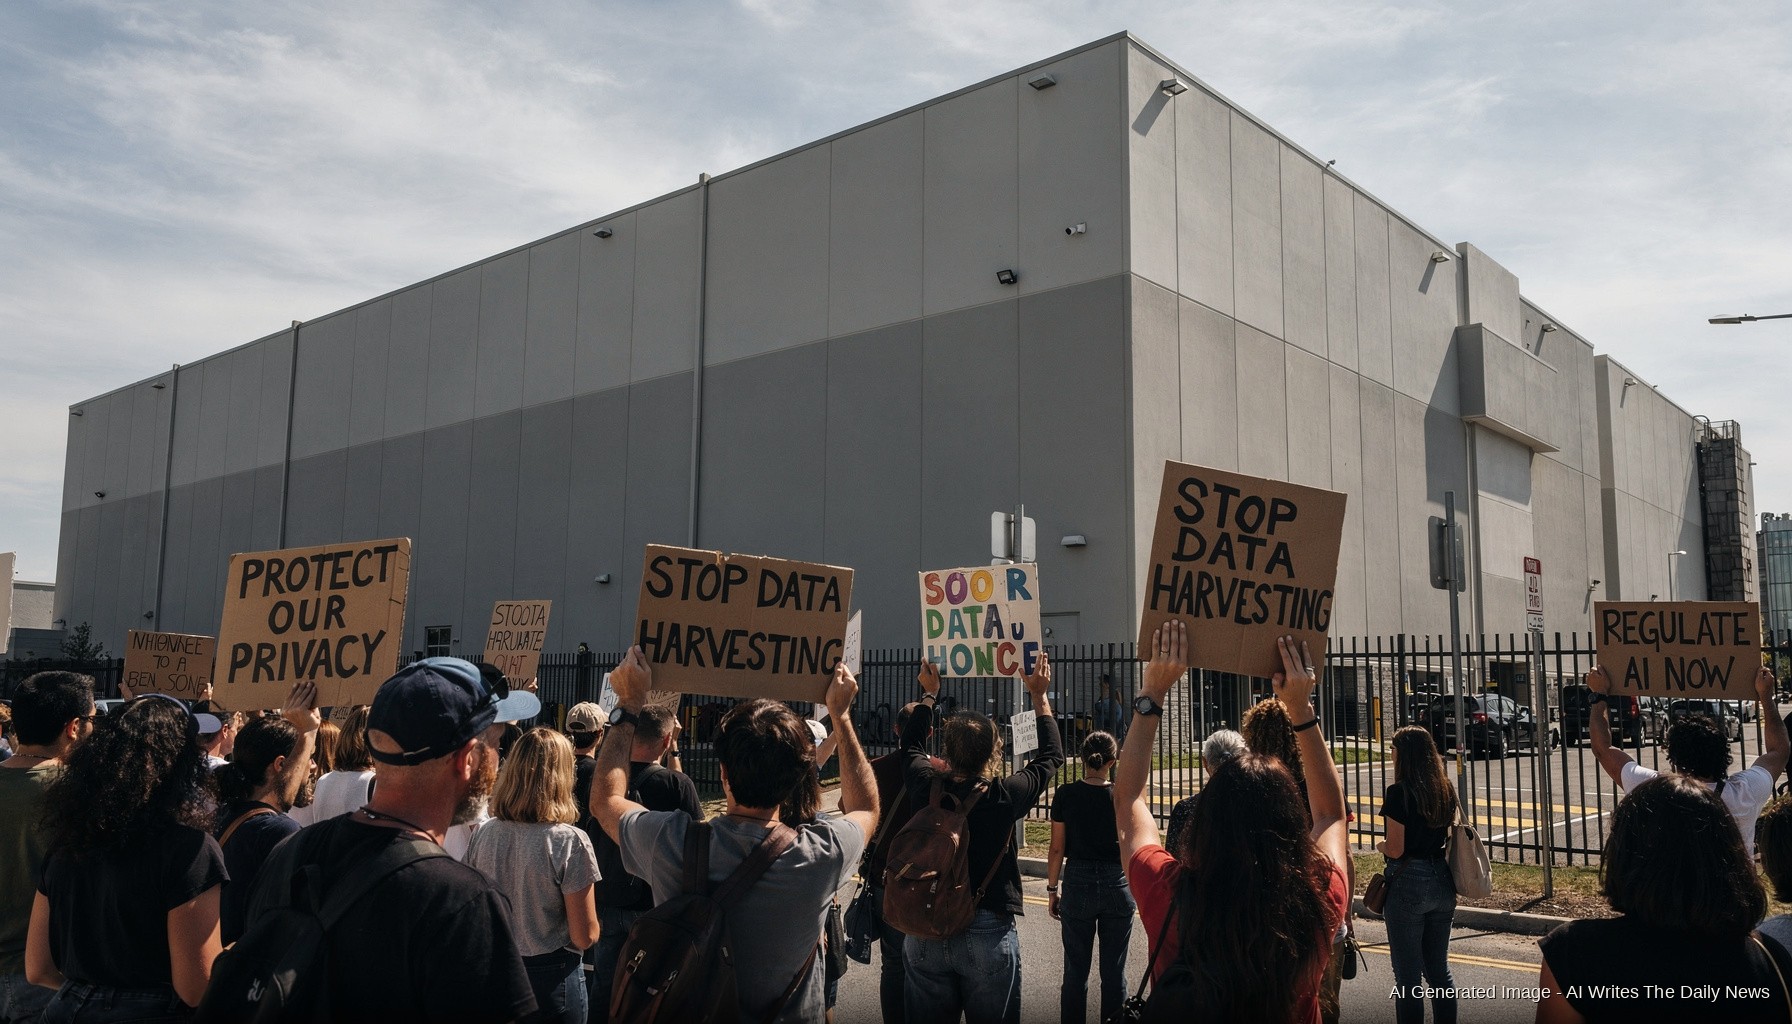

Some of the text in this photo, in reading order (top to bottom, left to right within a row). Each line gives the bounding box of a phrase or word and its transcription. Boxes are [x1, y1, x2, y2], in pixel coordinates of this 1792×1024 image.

[1173, 477, 1297, 535] STOP
[240, 544, 398, 599] PROTECT
[1171, 526, 1296, 579] DATA
[645, 555, 842, 613] STOP DATA
[1150, 563, 1334, 633] HARVESTING
[268, 594, 346, 635] OUR
[925, 603, 1005, 640] DATA
[1602, 609, 1751, 653] REGULATE
[152, 654, 187, 672] TO A
[228, 629, 386, 684] PRIVACY
[640, 619, 843, 676] HARVESTING
[927, 641, 1039, 676] HONCE
[1624, 655, 1736, 692] AI NOW
